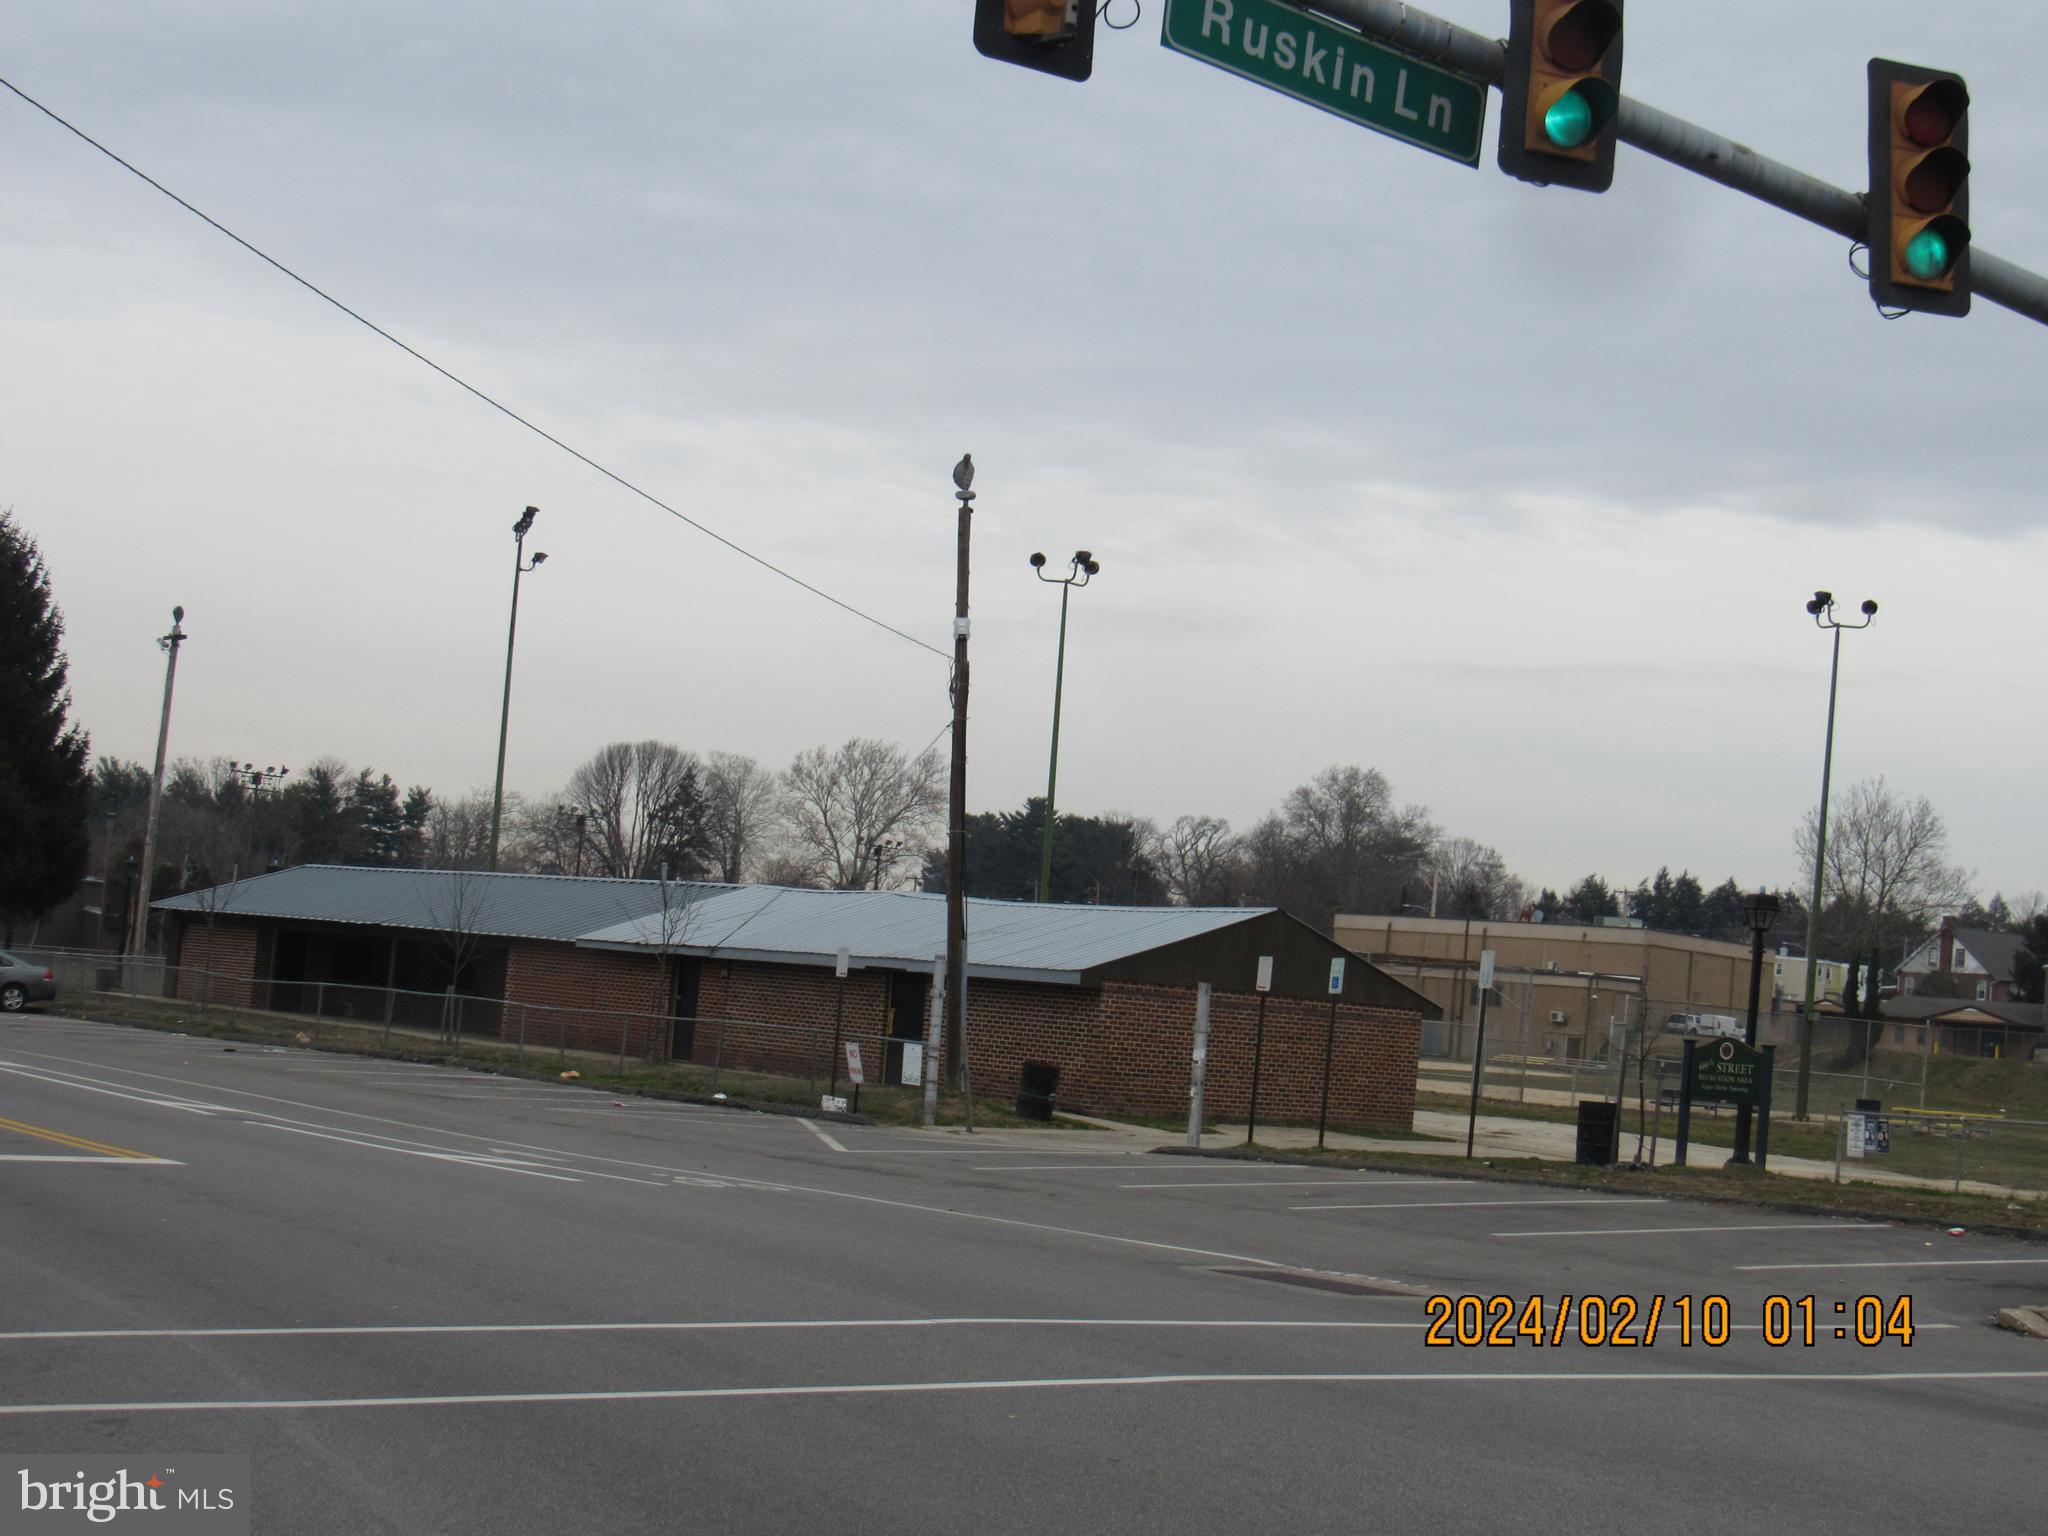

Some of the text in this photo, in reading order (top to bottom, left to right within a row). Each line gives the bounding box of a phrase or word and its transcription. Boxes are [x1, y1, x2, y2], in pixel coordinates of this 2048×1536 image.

[1201, 0, 1453, 133] Ruskin Ln
[1716, 1062, 1754, 1075] STREET
